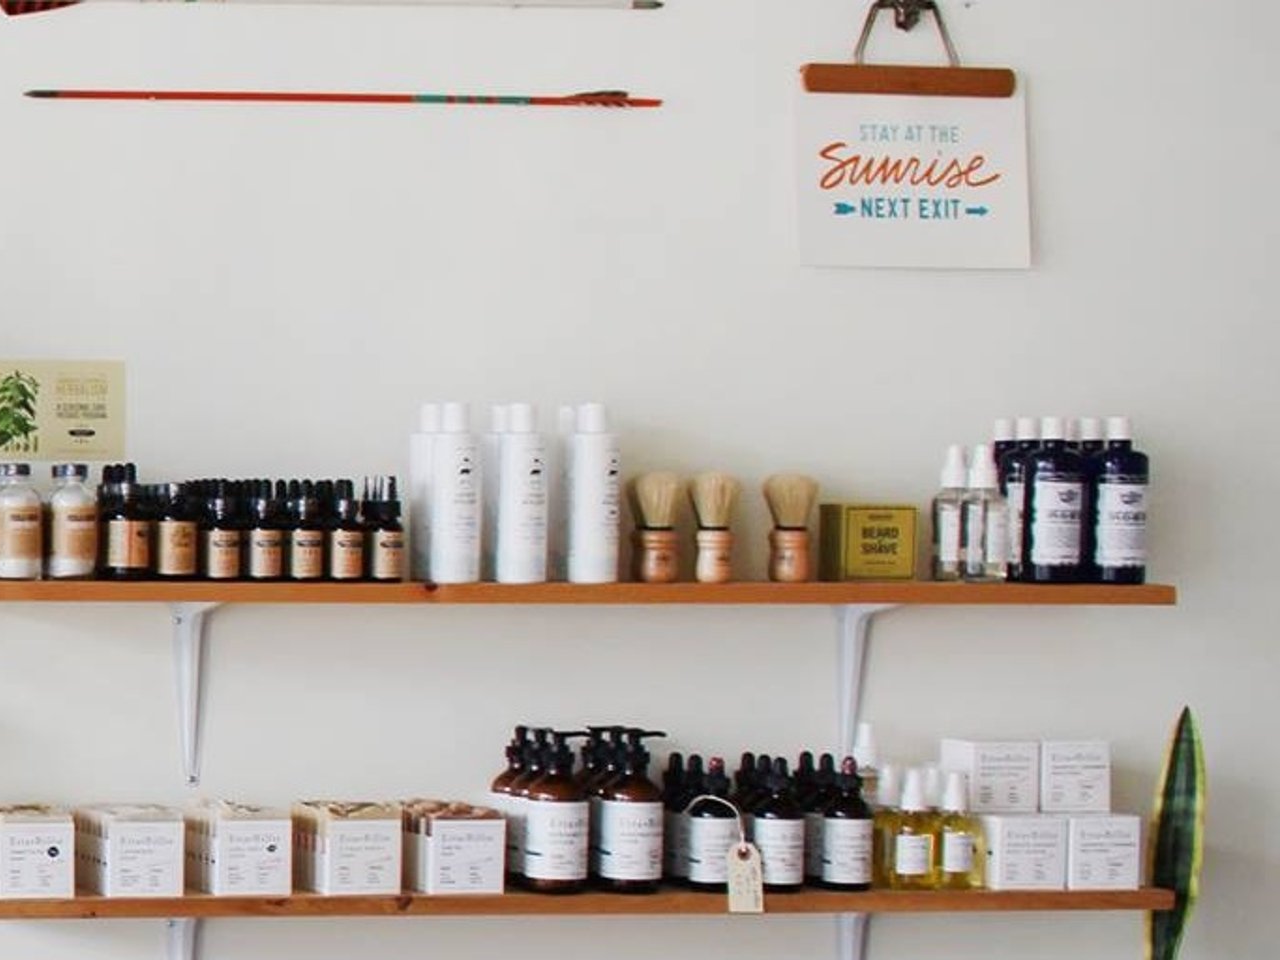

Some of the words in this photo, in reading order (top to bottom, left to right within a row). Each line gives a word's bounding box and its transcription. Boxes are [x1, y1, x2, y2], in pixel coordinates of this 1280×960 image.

[859, 125, 898, 141] STAY
[905, 125, 924, 142] AT
[930, 126, 959, 143] THE
[818, 142, 1001, 189] Sunrise
[860, 198, 912, 218] NEXT
[919, 199, 961, 219] EXIT
